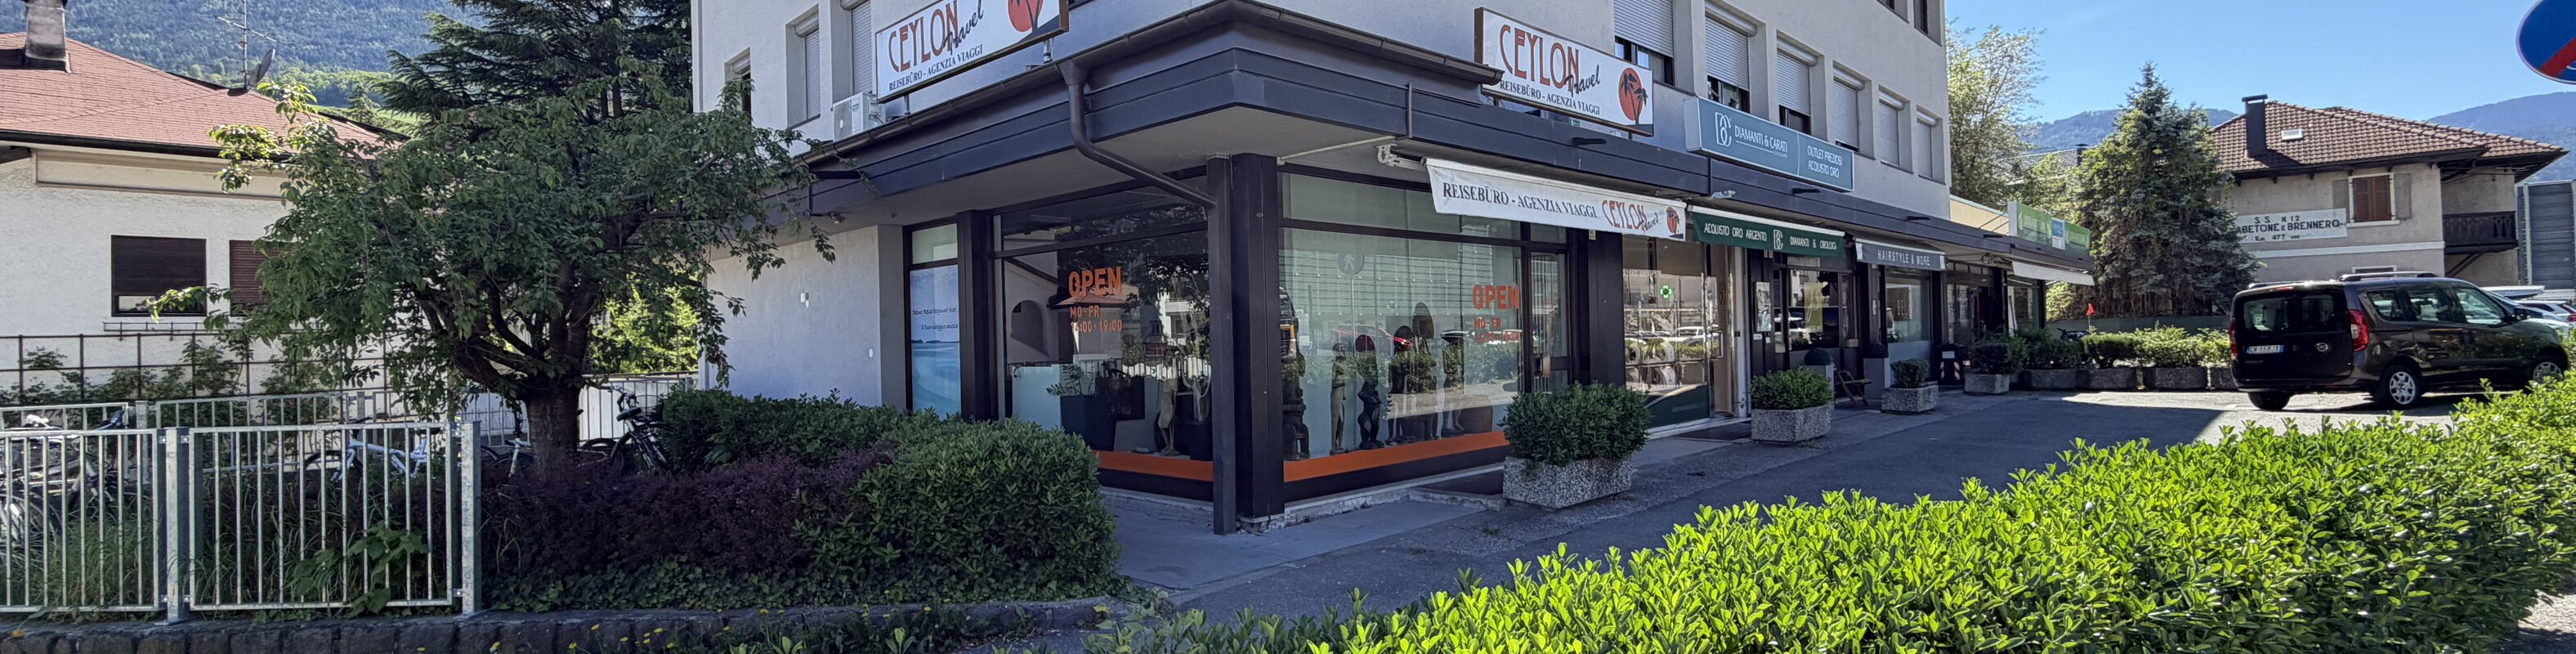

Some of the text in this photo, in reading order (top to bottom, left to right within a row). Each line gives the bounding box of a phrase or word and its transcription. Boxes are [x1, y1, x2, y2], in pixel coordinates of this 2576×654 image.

[888, 0, 958, 72] CEYLON
[889, 70, 923, 92] REISEBÜRO
[927, 57, 956, 77] AGENZIA
[957, 44, 983, 64] VIAGGI
[1500, 24, 1579, 92] CEYLON
[1500, 80, 1541, 100] REISEBÜRO
[1546, 92, 1576, 110] AGENZIA
[1577, 100, 1600, 116] VIAGGI
[1734, 125, 1788, 154] DIAMANTI & CARATI
[1807, 146, 1843, 166] OUTLET PREZIOSI
[1808, 159, 1840, 178] ACQUISTO ORO
[1443, 182, 1509, 205] REISEBÜRO
[1518, 195, 1563, 213] AGENZIA
[1562, 201, 1598, 218] VIAGGI
[1603, 199, 1648, 230] CEYLON
[1704, 222, 1729, 236] ACQUISTO
[1732, 226, 1743, 238] ORO
[1746, 229, 1768, 242] ARGENTO
[1790, 235, 1809, 248] DIAMANTI
[2287, 218, 2340, 231] BRENNERO
[1877, 249, 1909, 264] HAIRSTYLE
[1916, 255, 1930, 267] MORE
[1068, 266, 1122, 298] OPEN
[1473, 284, 1519, 310] OPEN
[1070, 306, 1083, 318] MO
[1088, 305, 1100, 318] FR
